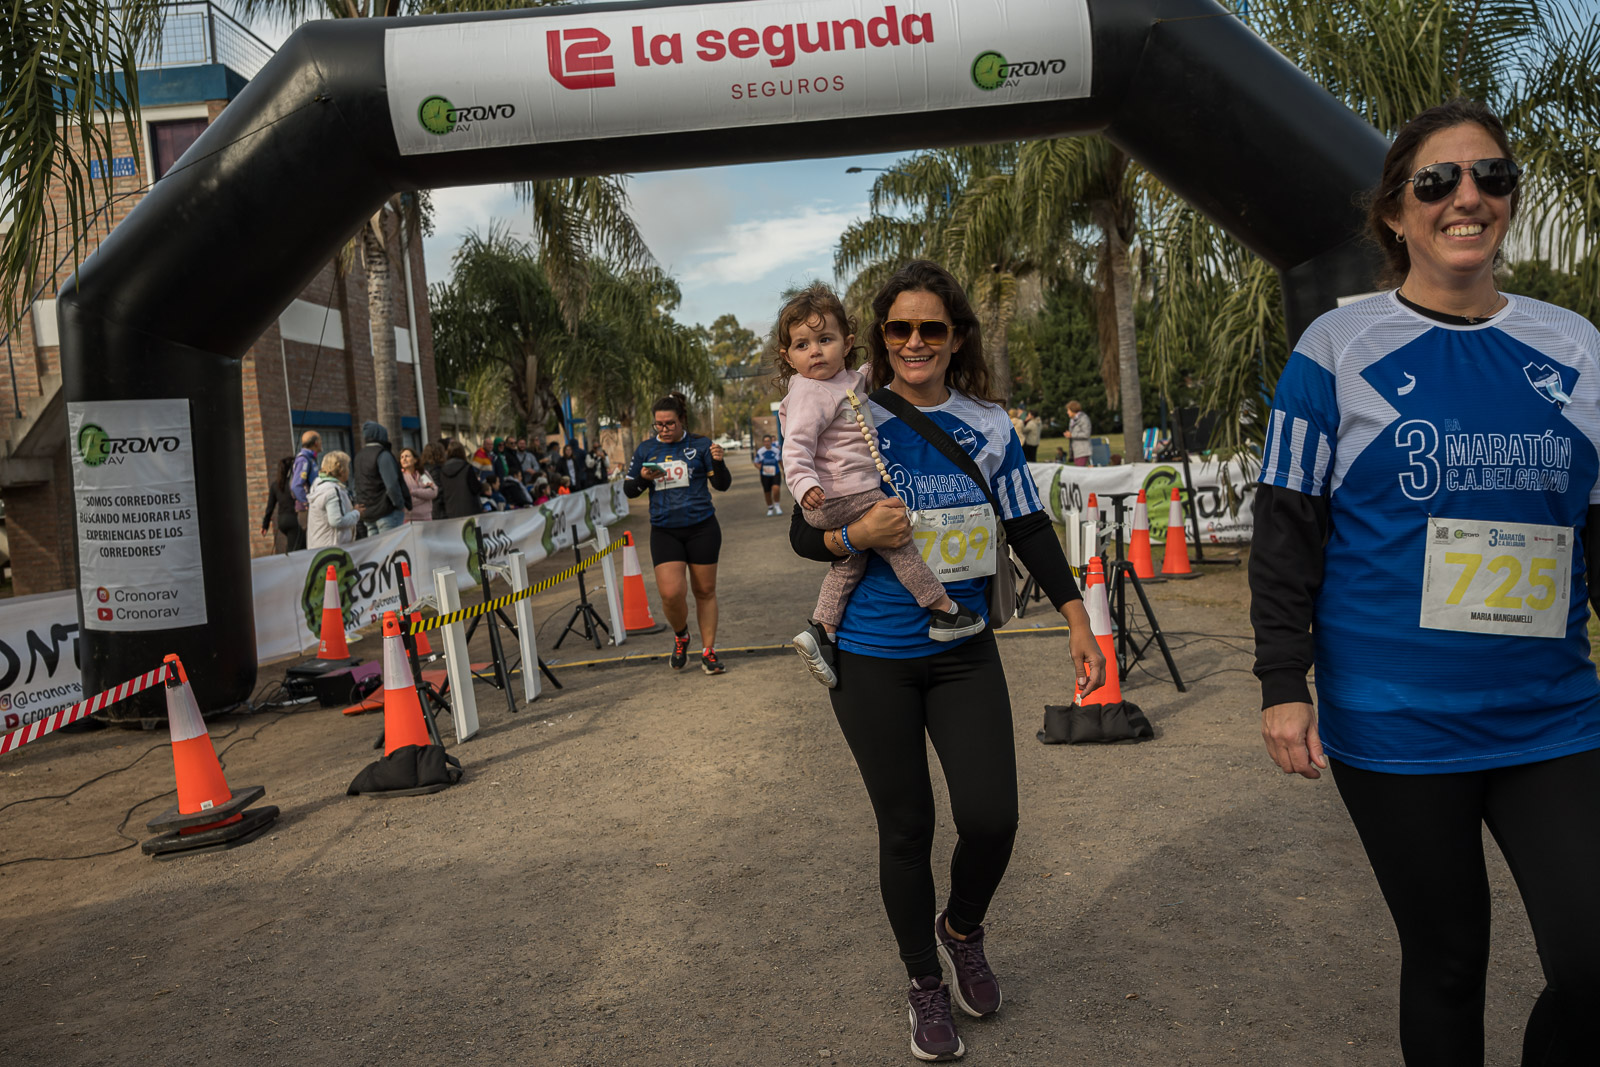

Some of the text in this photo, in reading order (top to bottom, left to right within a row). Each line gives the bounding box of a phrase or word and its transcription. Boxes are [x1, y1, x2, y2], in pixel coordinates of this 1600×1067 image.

[632, 5, 934, 69] la segunda
[998, 59, 1067, 79] CRONO
[731, 75, 845, 100] SEGUROS
[996, 79, 1021, 89] RAV
[446, 104, 516, 123] CRONO
[446, 123, 471, 134] RAV
[99, 436, 180, 454] CRONO
[1445, 430, 1572, 469] MARATÓN
[99, 456, 125, 465] RAV
[1395, 419, 1441, 500] 3
[114, 493, 181, 507] CORREDORES
[80, 508, 191, 524] BUSCANDO MEJORAR LAS
[86, 527, 183, 541] EXPERIENCIAS DE LOS
[1488, 528, 1499, 547] 3
[913, 526, 989, 565] 709
[1444, 551, 1558, 611] 725
[114, 588, 179, 602] Cronorav
[116, 606, 180, 620] Cronorav
[1470, 612, 1533, 624] MARIA MANGIAMELLI
